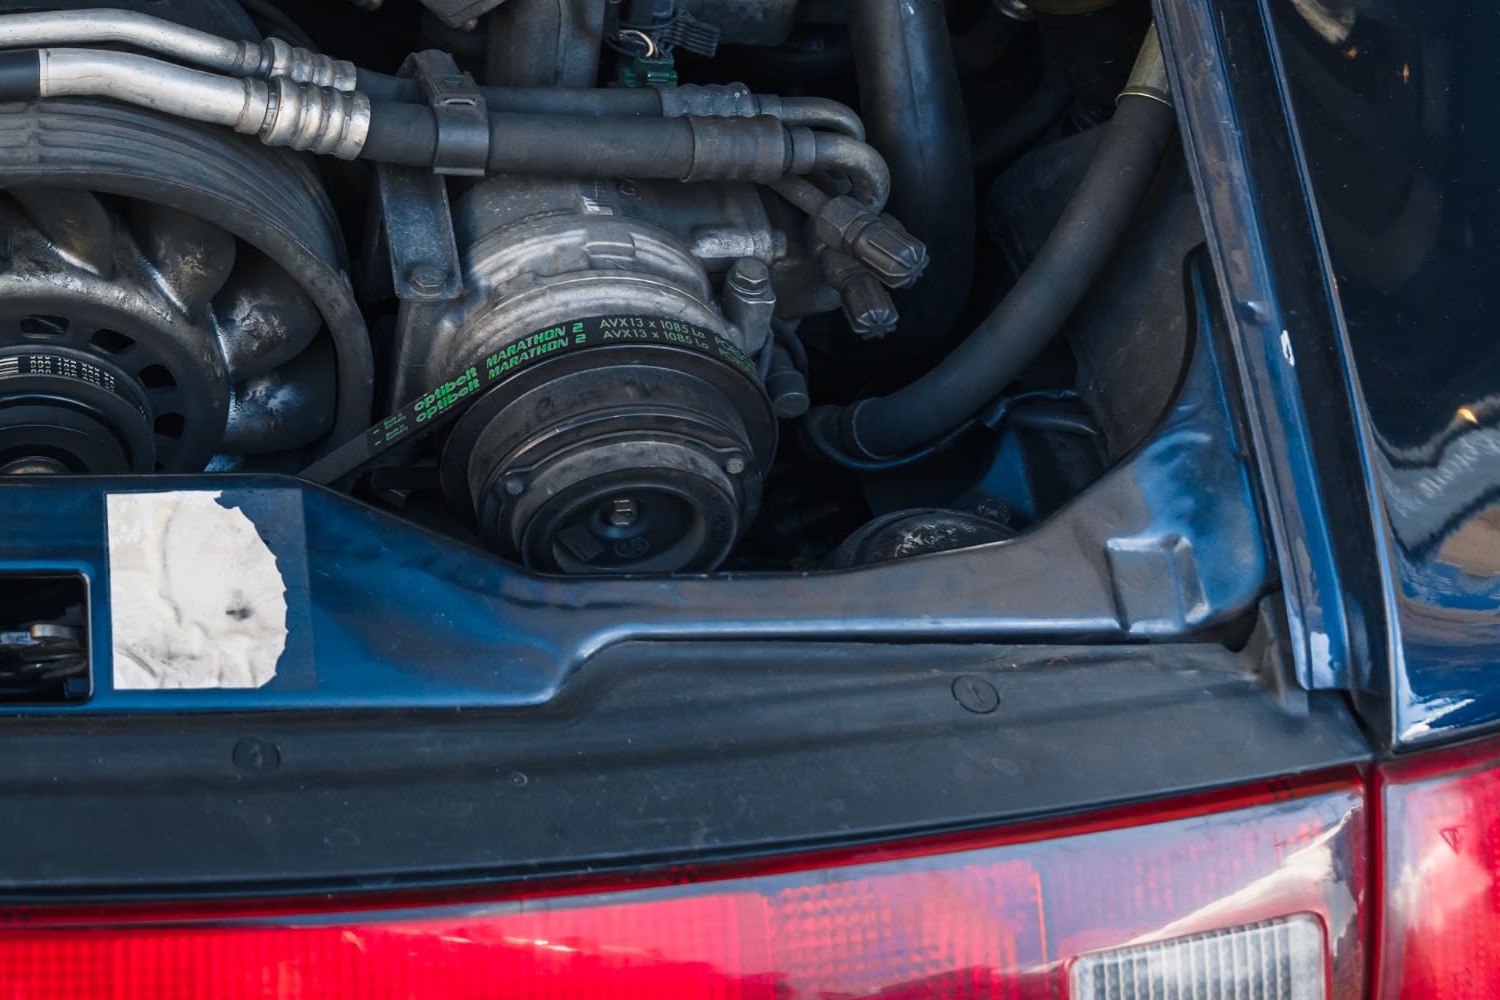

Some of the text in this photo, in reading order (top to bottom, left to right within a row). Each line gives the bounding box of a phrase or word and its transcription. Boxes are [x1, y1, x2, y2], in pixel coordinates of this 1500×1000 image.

[414, 367, 478, 411] optibelt
[487, 325, 566, 368] MARATHON
[572, 322, 584, 333] 2
[660, 319, 689, 334] 1085
[416, 378, 480, 422] optibelt
[488, 337, 569, 380] MARATHON
[575, 333, 587, 344] 2
